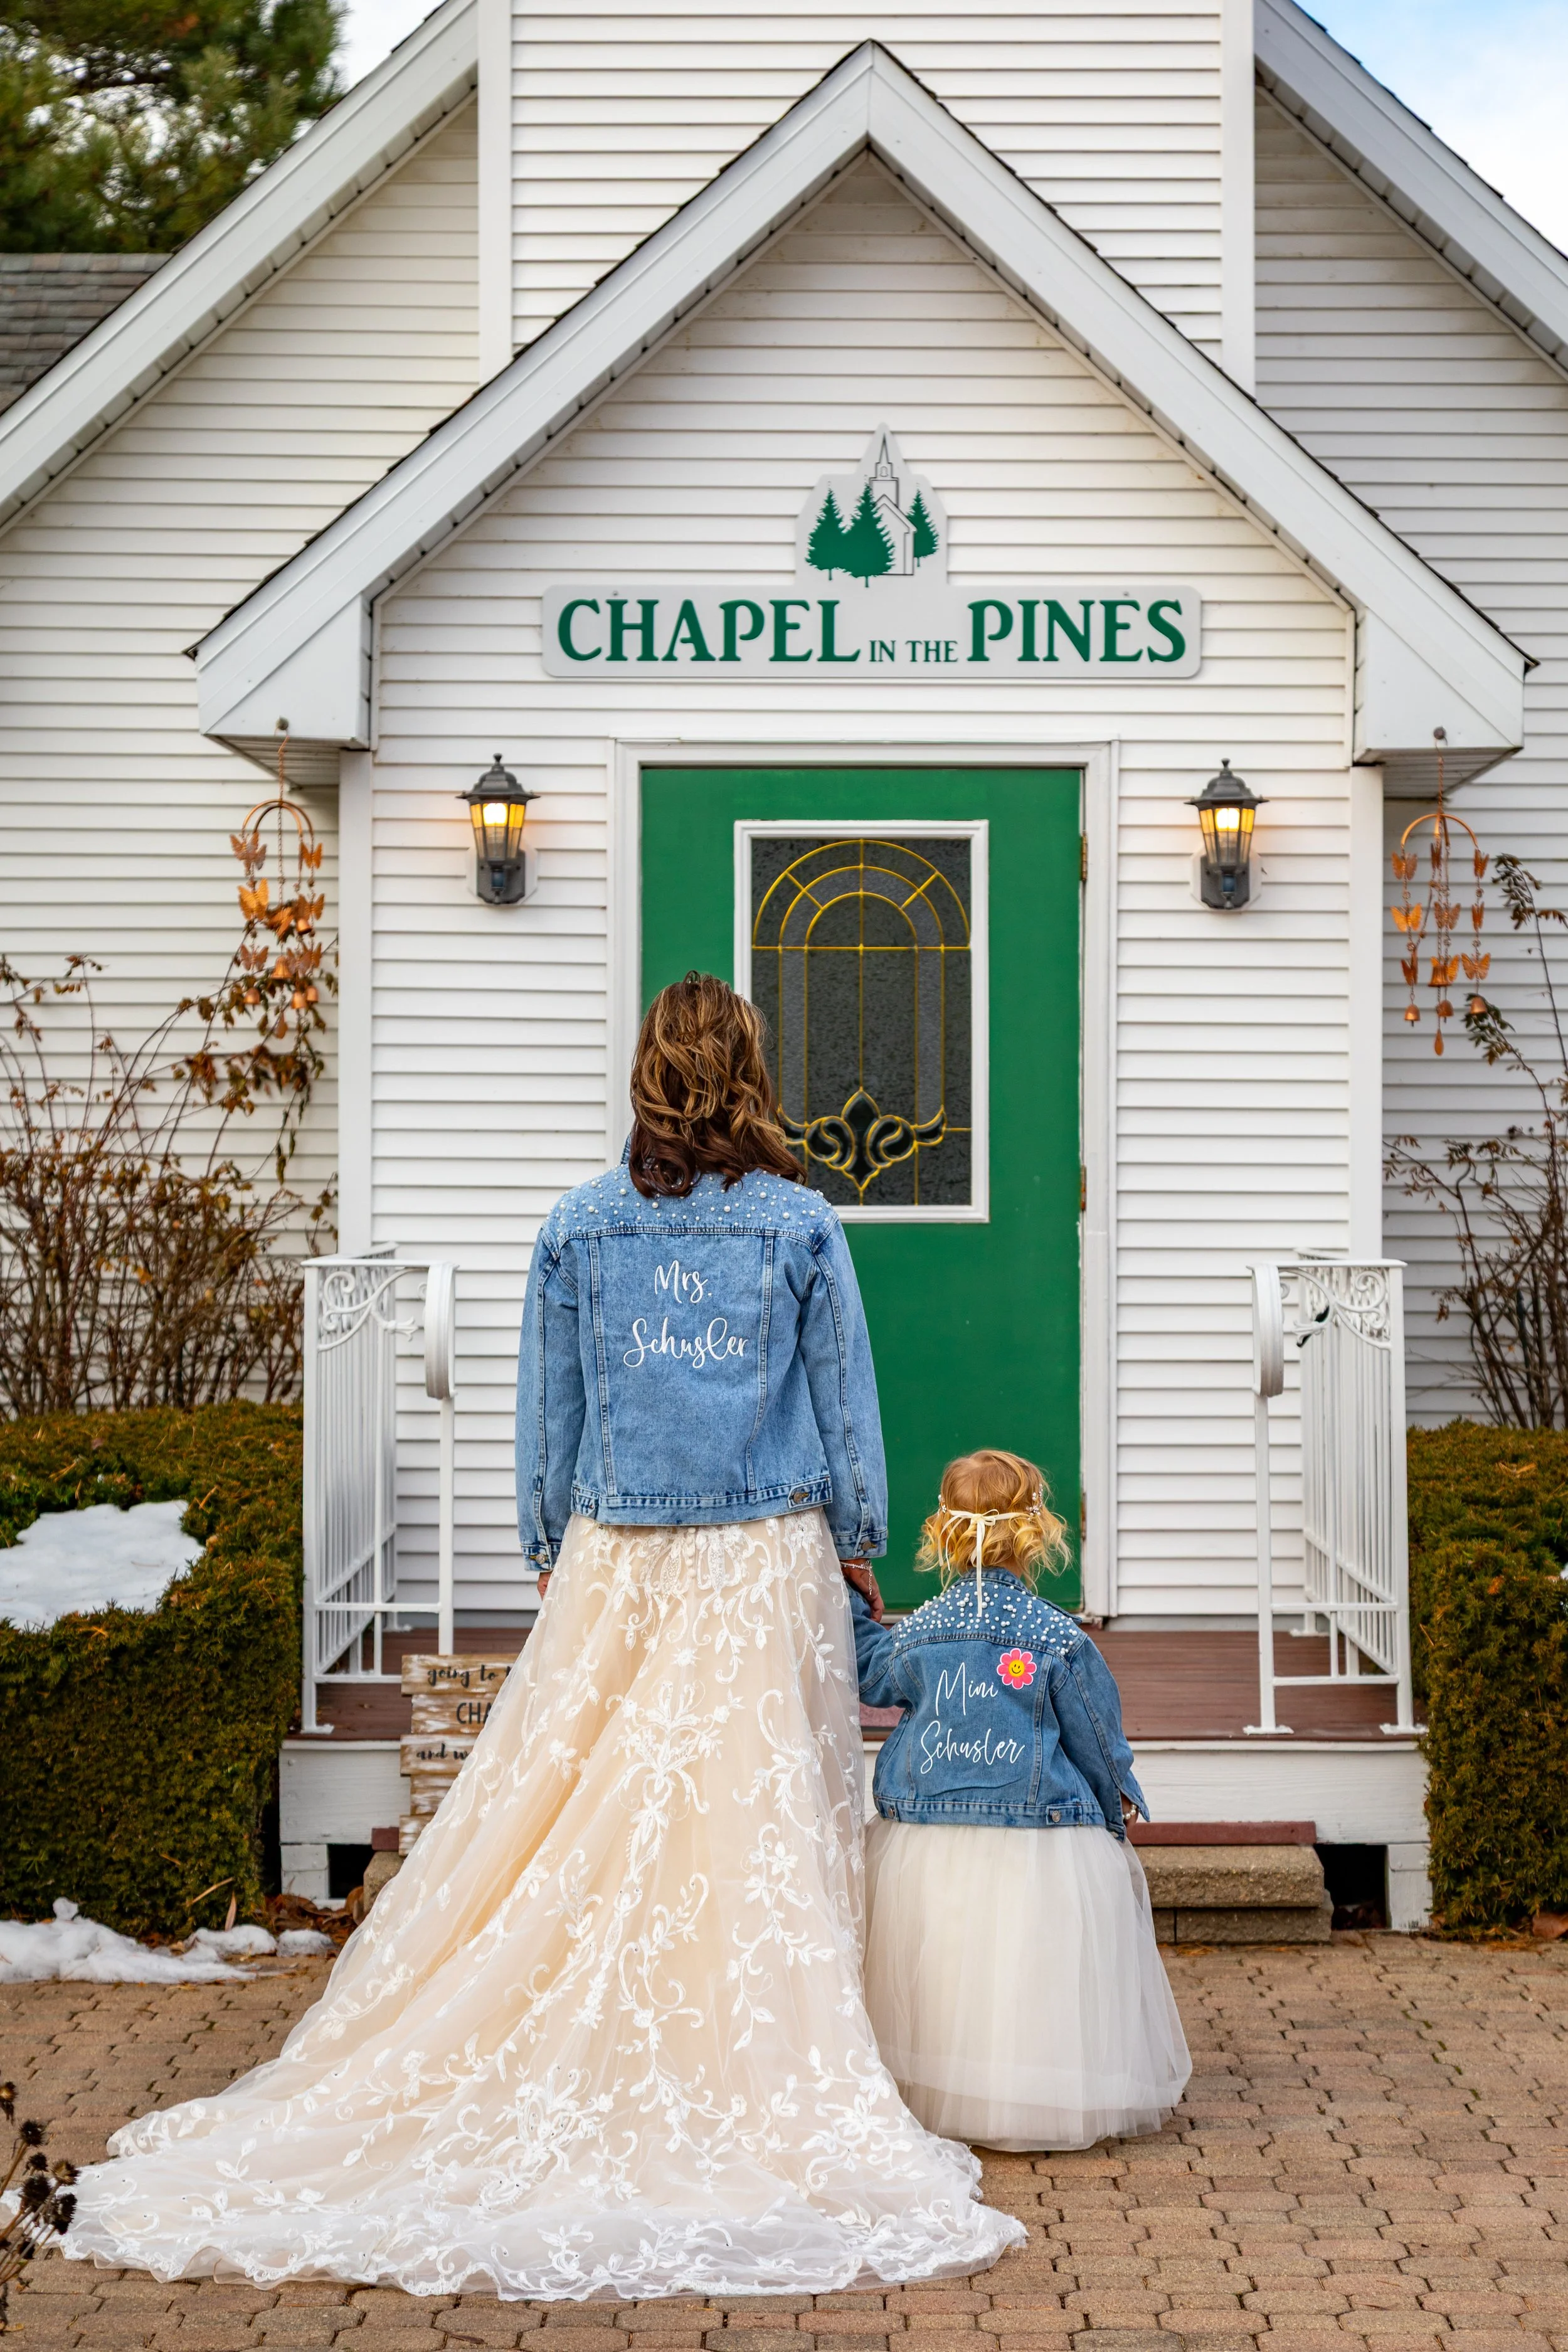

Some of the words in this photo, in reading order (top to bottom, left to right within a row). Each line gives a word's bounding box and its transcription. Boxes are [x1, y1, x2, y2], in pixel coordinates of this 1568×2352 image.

[558, 599, 861, 662] CHAPEL
[869, 640, 896, 663] IN
[905, 640, 958, 663] THE
[967, 599, 1186, 663] PINES
[654, 1260, 712, 1303] Mrs.
[427, 1666, 470, 1688] going
[480, 1665, 499, 1682] to
[935, 1662, 999, 1716] Mini
[416, 1742, 447, 1761] and
